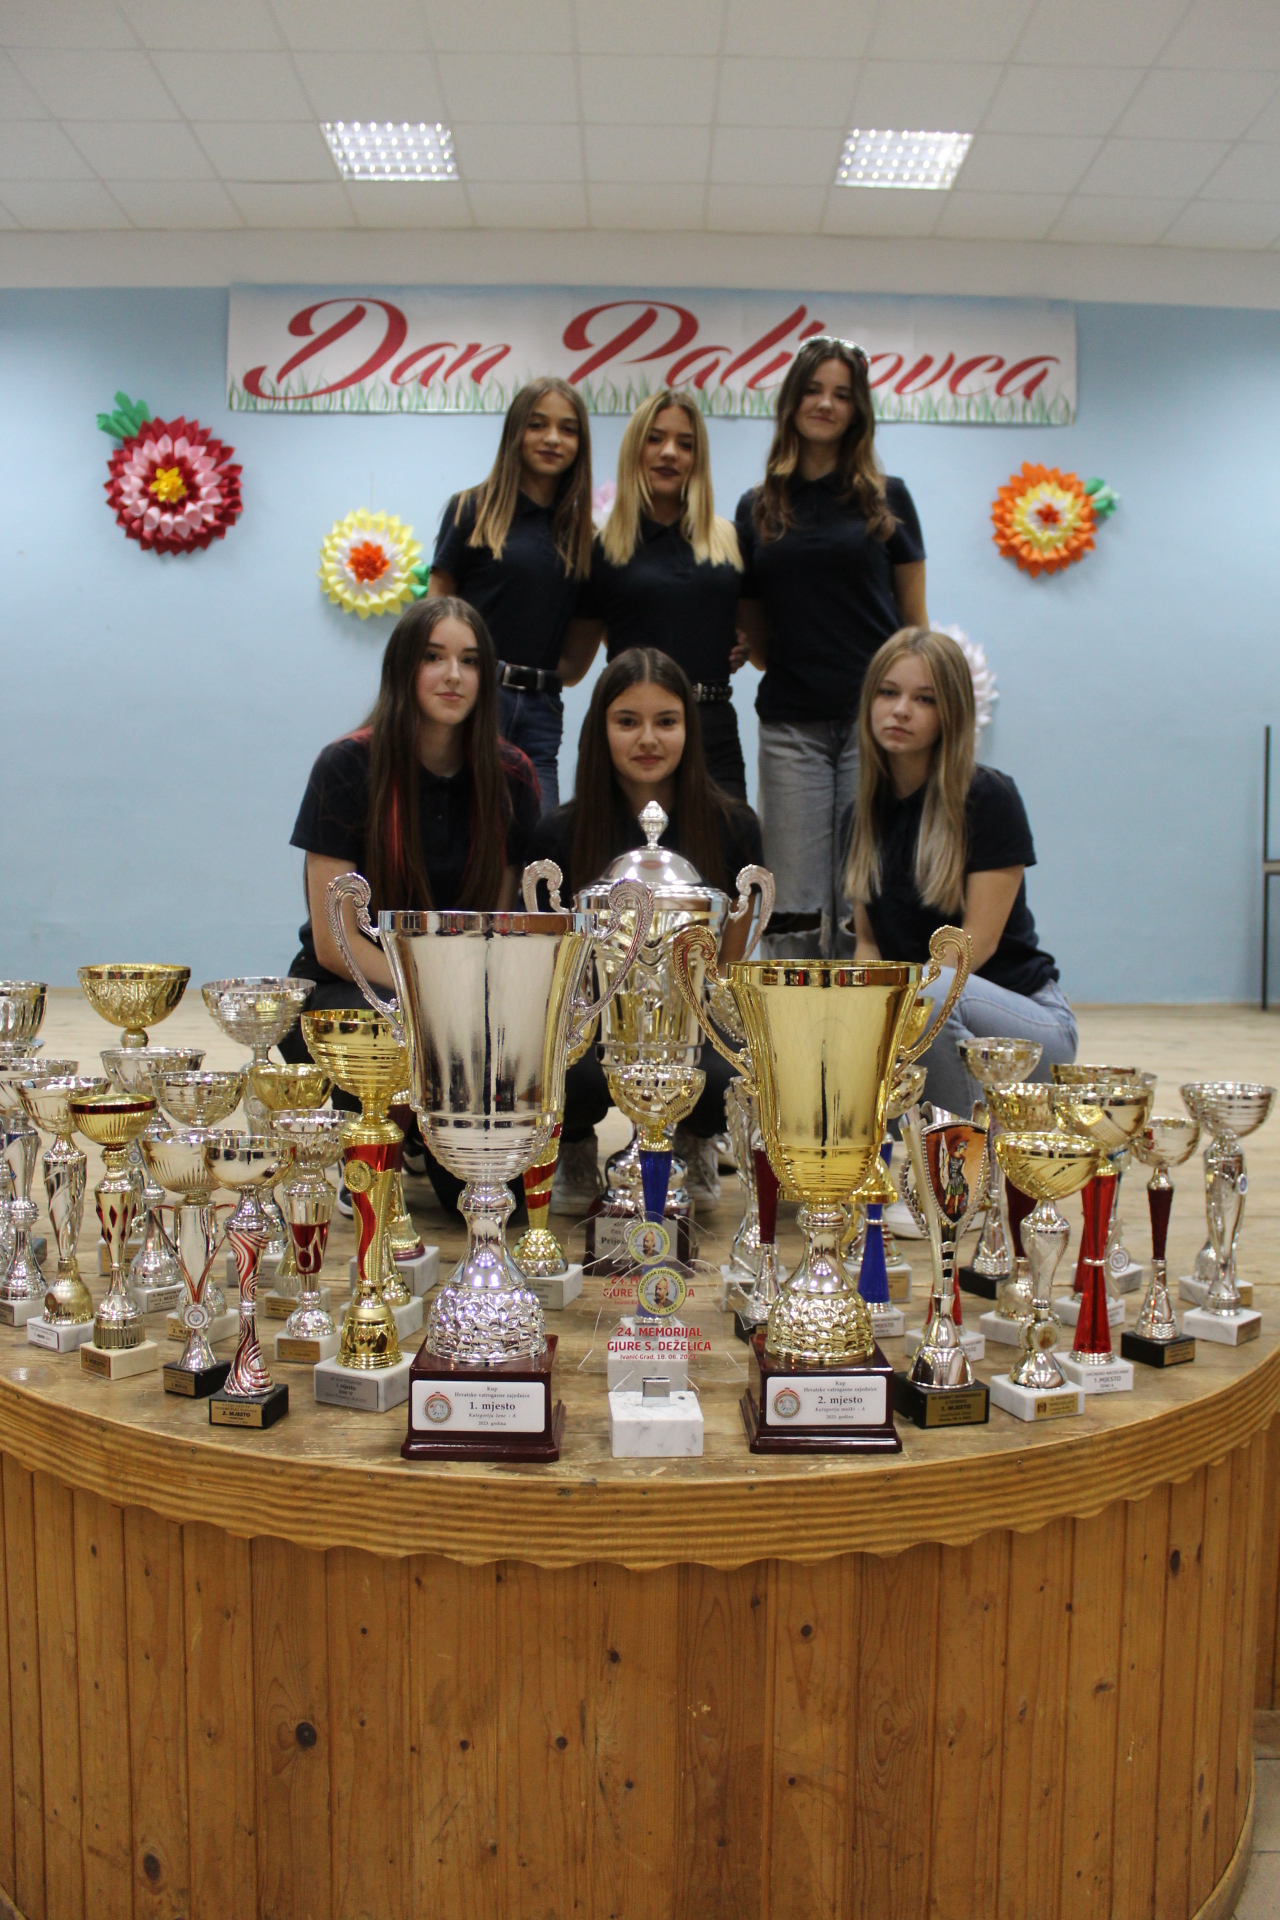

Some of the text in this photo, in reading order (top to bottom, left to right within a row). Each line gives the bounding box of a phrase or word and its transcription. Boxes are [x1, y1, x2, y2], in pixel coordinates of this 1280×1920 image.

[243, 298, 1060, 400] Dan Paliovca
[617, 1327, 702, 1338] 24. MEMORIJAL
[607, 1338, 712, 1353] GJURE S. DEŽELIĆA
[818, 1395, 863, 1406] 2. mjesto
[470, 1401, 516, 1412] 1. mjesto
